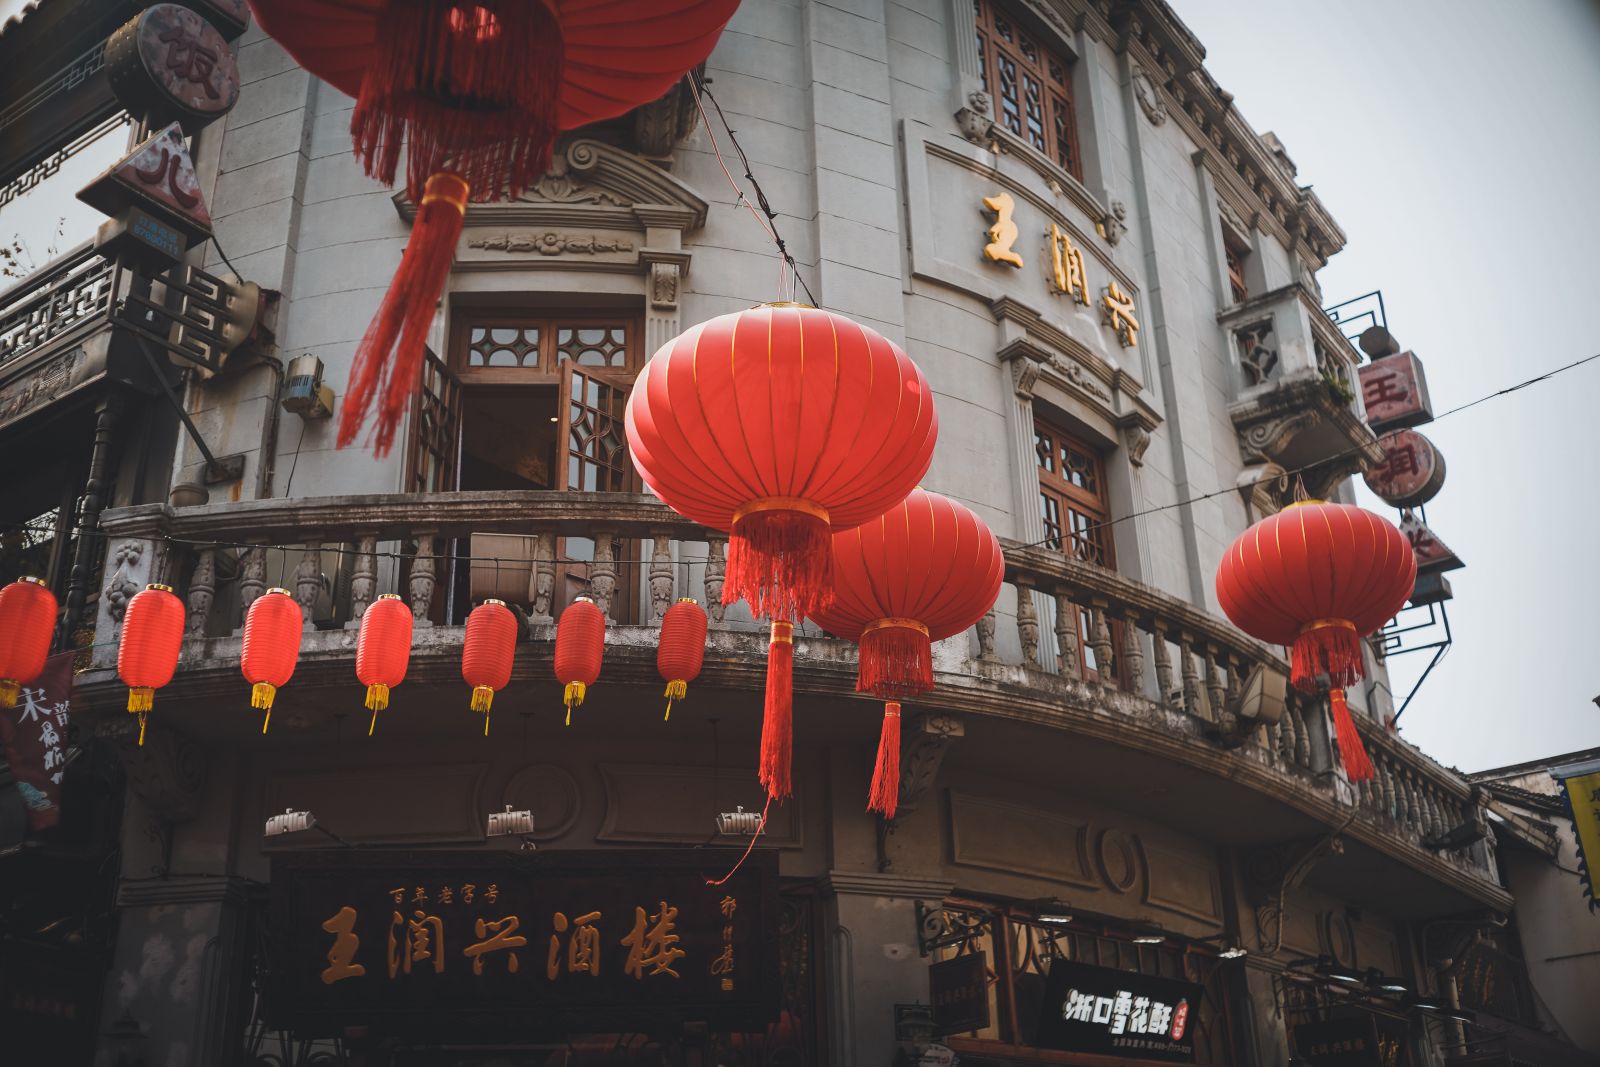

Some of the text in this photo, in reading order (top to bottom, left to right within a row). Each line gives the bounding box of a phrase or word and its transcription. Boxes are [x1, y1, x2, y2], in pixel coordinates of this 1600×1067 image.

[982, 191, 1139, 347] 王润兴
[388, 883, 500, 905] 百年老字号
[321, 901, 686, 985] 王润兴酒楼
